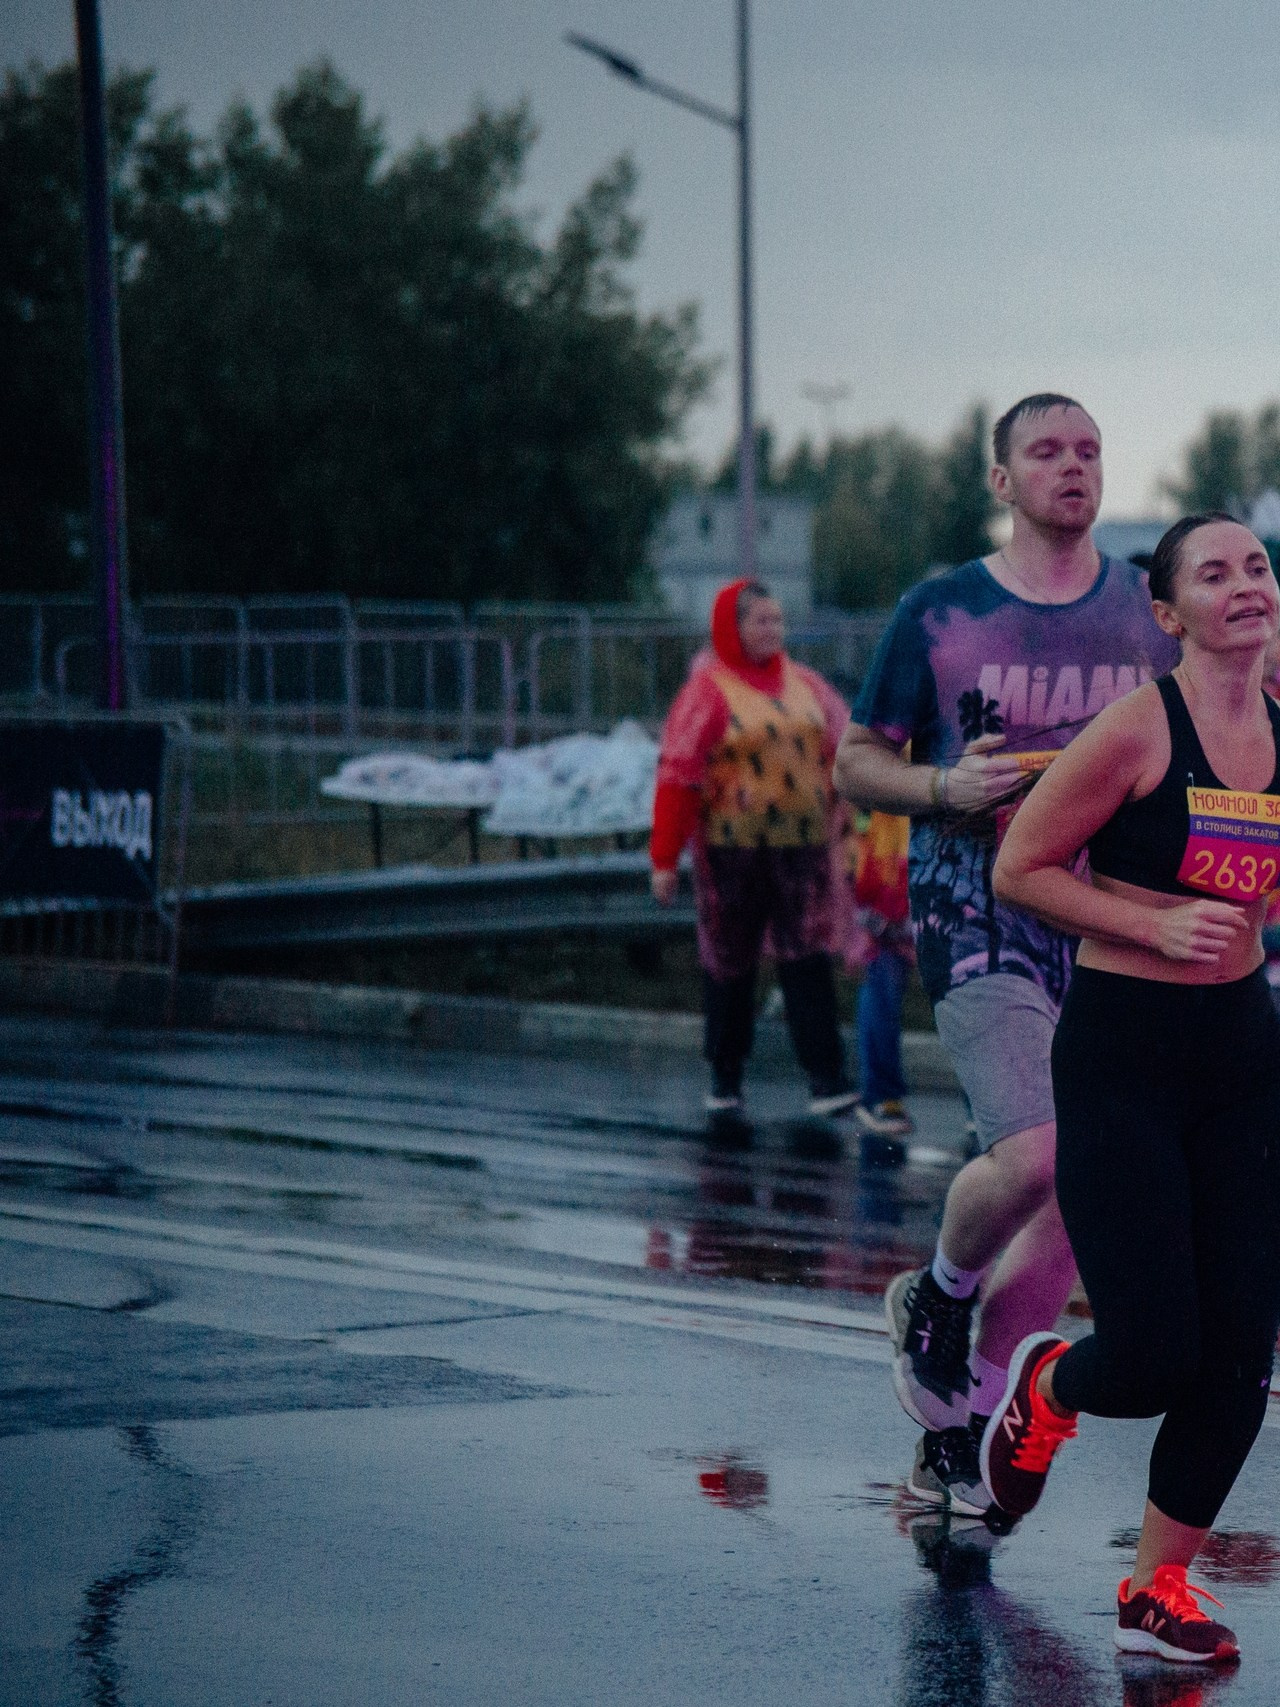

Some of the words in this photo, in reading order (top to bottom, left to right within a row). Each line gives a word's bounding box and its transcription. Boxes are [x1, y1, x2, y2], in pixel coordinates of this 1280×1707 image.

[1194, 793, 1258, 815] НОЧНОЙ
[52, 787, 152, 861] ВЫХОД
[1195, 820, 1202, 830] В
[1203, 822, 1242, 836] СТОЛИЦЕ
[1243, 827, 1279, 840] ЗАКАТОВ
[1188, 850, 1277, 895] 2632
